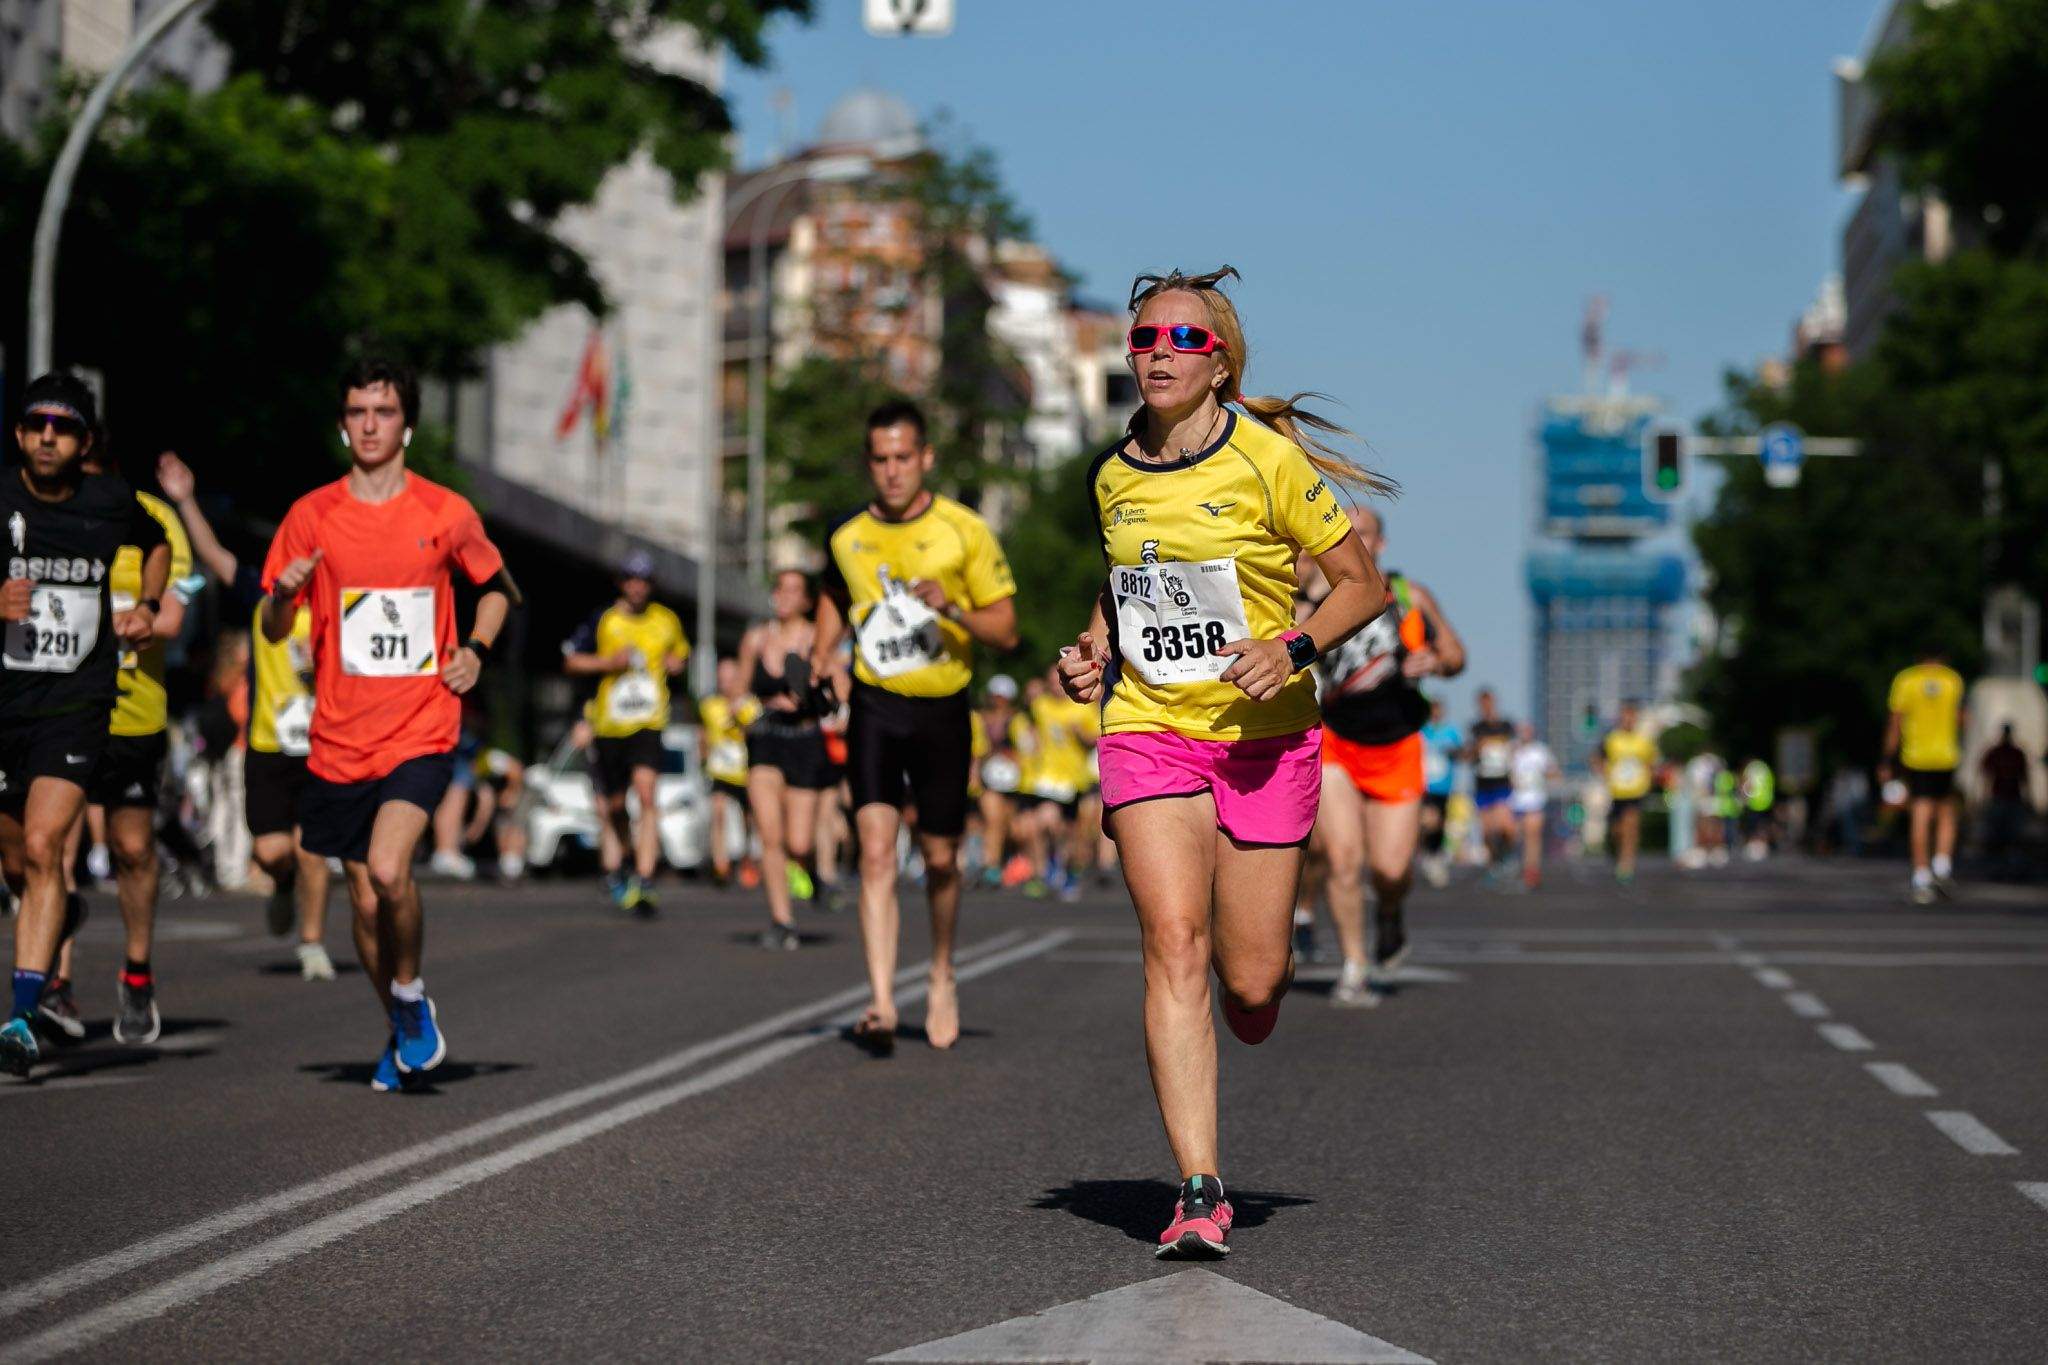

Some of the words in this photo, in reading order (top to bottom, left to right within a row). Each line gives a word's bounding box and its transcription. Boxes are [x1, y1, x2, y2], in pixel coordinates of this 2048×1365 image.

[1120, 571, 1152, 599] 8812
[1176, 594, 1188, 604] 13
[24, 630, 80, 657] 3291
[370, 633, 409, 661] 371
[1141, 621, 1227, 662] 3358
